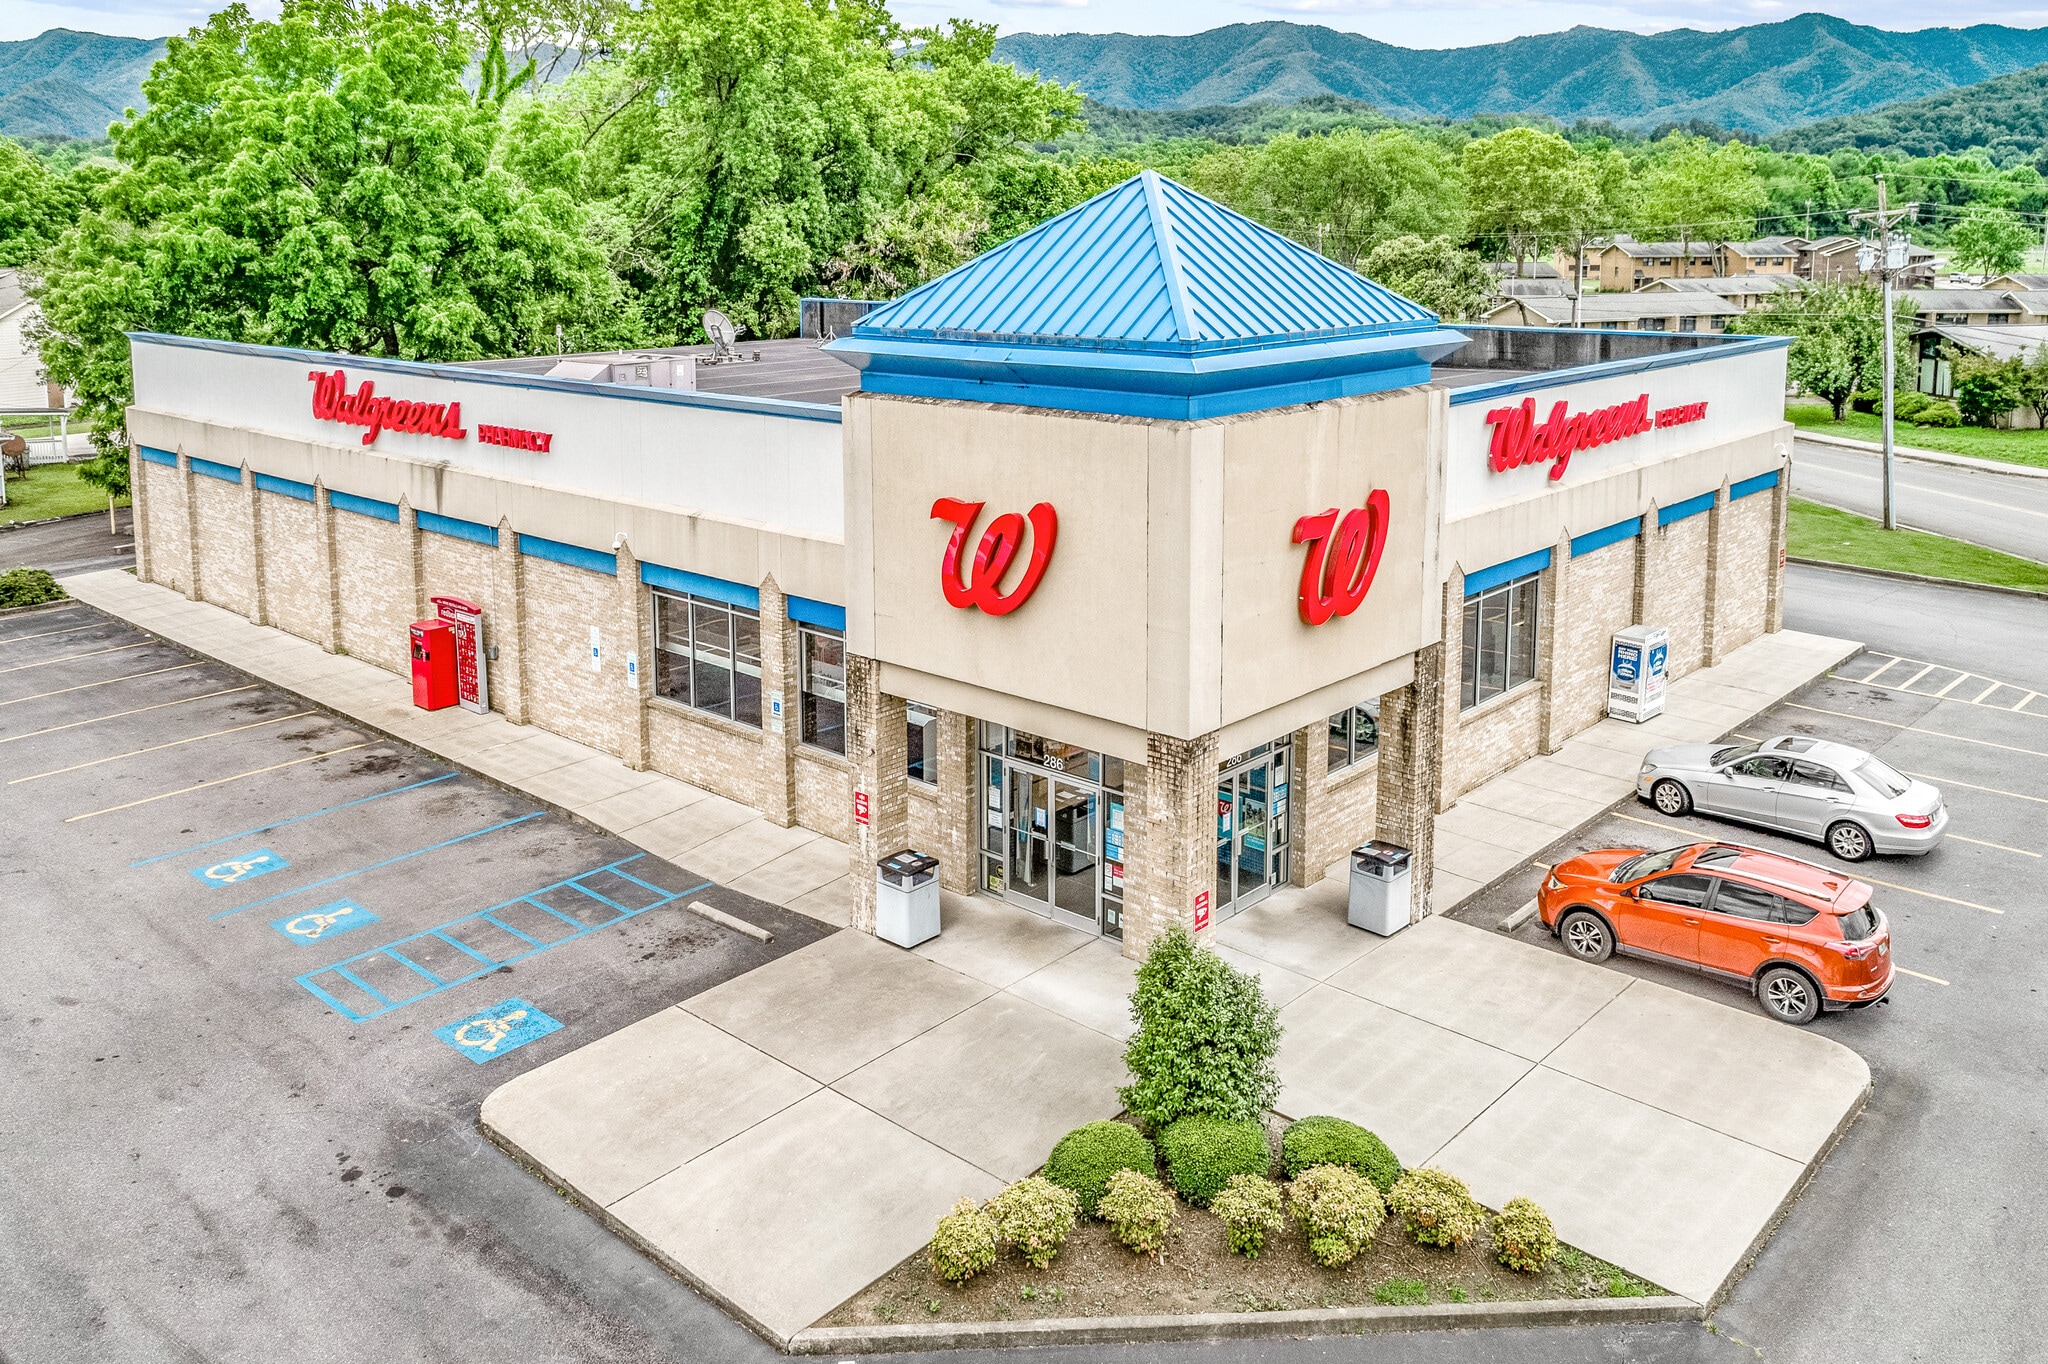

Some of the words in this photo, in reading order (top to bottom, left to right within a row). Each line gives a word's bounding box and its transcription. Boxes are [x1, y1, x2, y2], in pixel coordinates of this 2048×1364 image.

[308, 370, 467, 445] Walgreens
[478, 424, 553, 453] PHARMACY
[1486, 393, 1653, 481] Walgreens
[1655, 402, 1709, 430] PHARMACY
[930, 497, 1058, 616] W
[1292, 489, 1390, 626] W
[1043, 754, 1064, 771] 286
